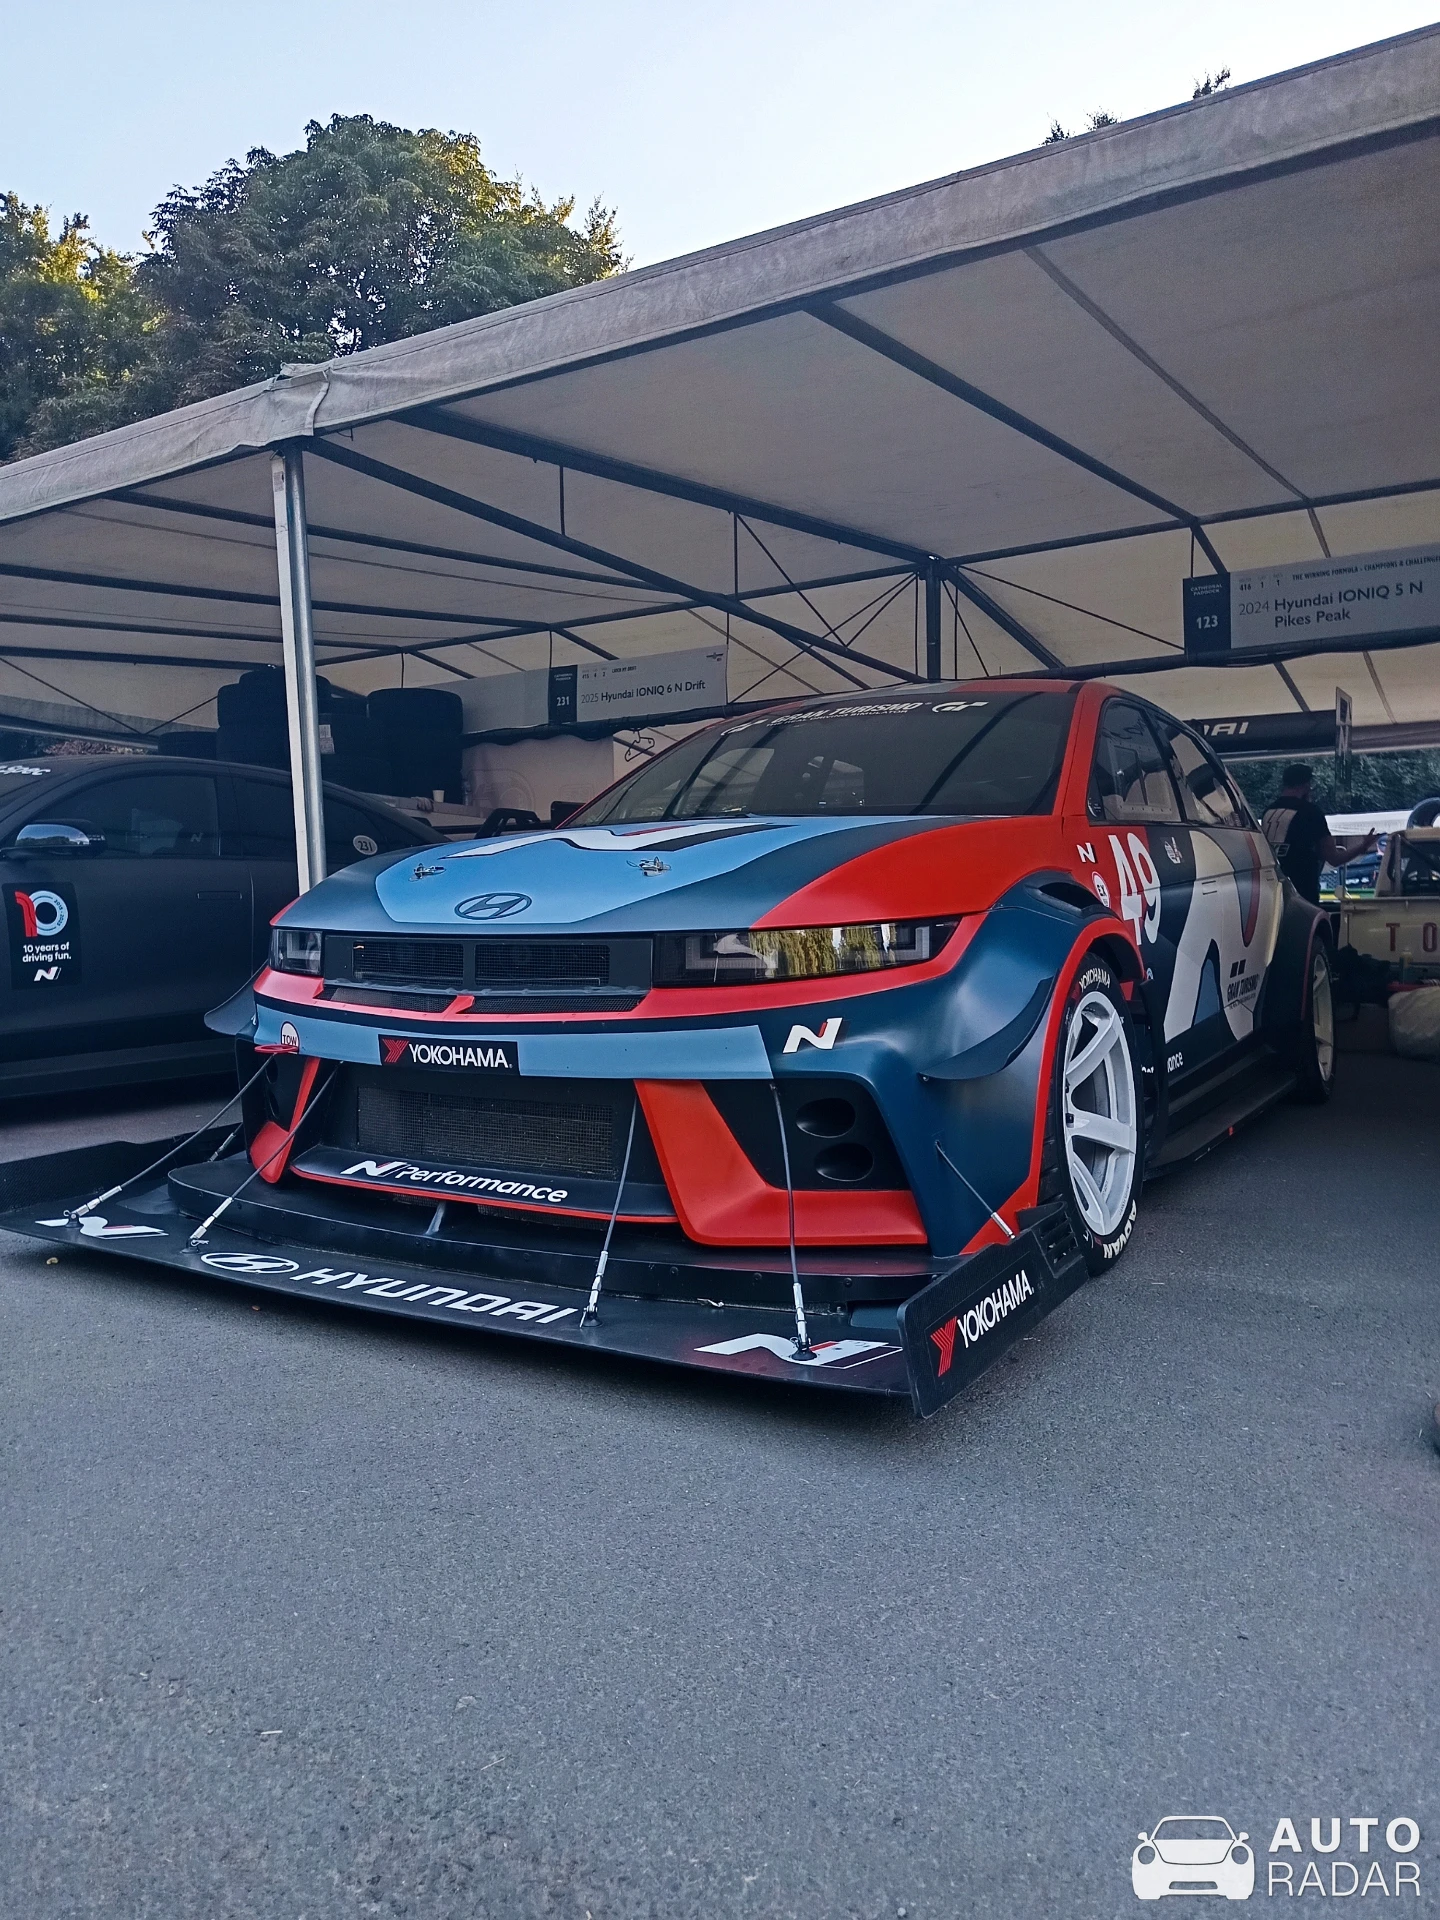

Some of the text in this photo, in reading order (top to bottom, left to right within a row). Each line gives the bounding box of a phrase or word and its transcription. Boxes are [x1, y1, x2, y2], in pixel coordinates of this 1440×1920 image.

[1239, 580, 1424, 616] 2024 Hyundai IONIQ 5 N
[1196, 614, 1219, 629] 123
[1274, 608, 1351, 630] Pikes Peak
[556, 695, 571, 708] 231
[581, 679, 706, 705] 2025 Hyundai IONIQ 6 N Drift
[358, 840, 373, 852] 231
[1107, 832, 1161, 946] 49
[22, 941, 70, 954] 10 years of
[22, 951, 72, 963] driving fun.
[1079, 968, 1111, 994] YOKOHAMA
[282, 1034, 298, 1047] TOW
[408, 1043, 511, 1069] YOKOHAMA
[399, 1166, 569, 1203] Performance
[1102, 1198, 1138, 1260] ADVAN
[290, 1266, 576, 1324] HYUNDAI
[956, 1268, 1034, 1349] YOKOHAMA
